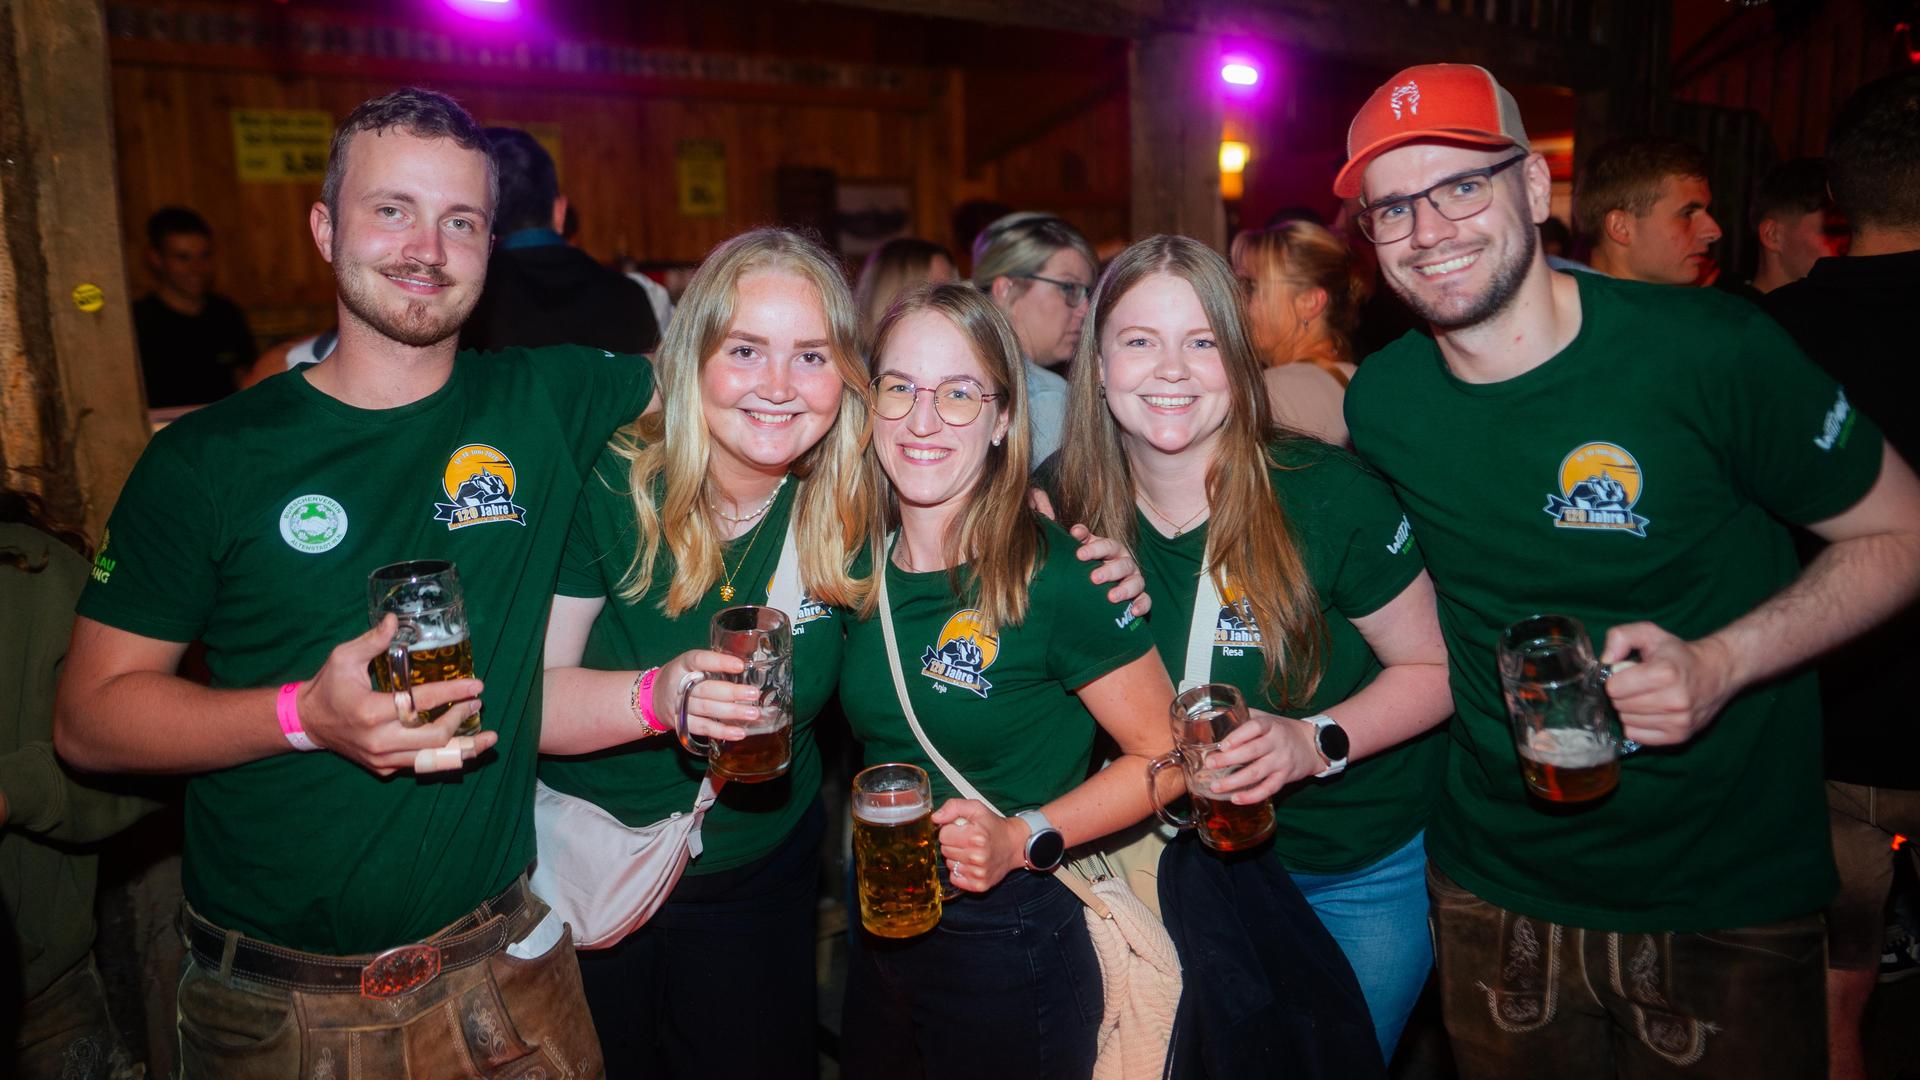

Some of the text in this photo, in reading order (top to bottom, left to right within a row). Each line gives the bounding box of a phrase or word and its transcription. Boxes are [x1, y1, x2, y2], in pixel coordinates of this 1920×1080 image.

[455, 507, 479, 521] 120
[480, 504, 509, 517] Jahre
[1588, 510, 1625, 524] Jahre
[799, 605, 821, 618] ahre
[792, 625, 805, 635] oni
[1222, 647, 1244, 656] Resa
[945, 665, 974, 684] Jahre
[932, 682, 948, 693] Anja
